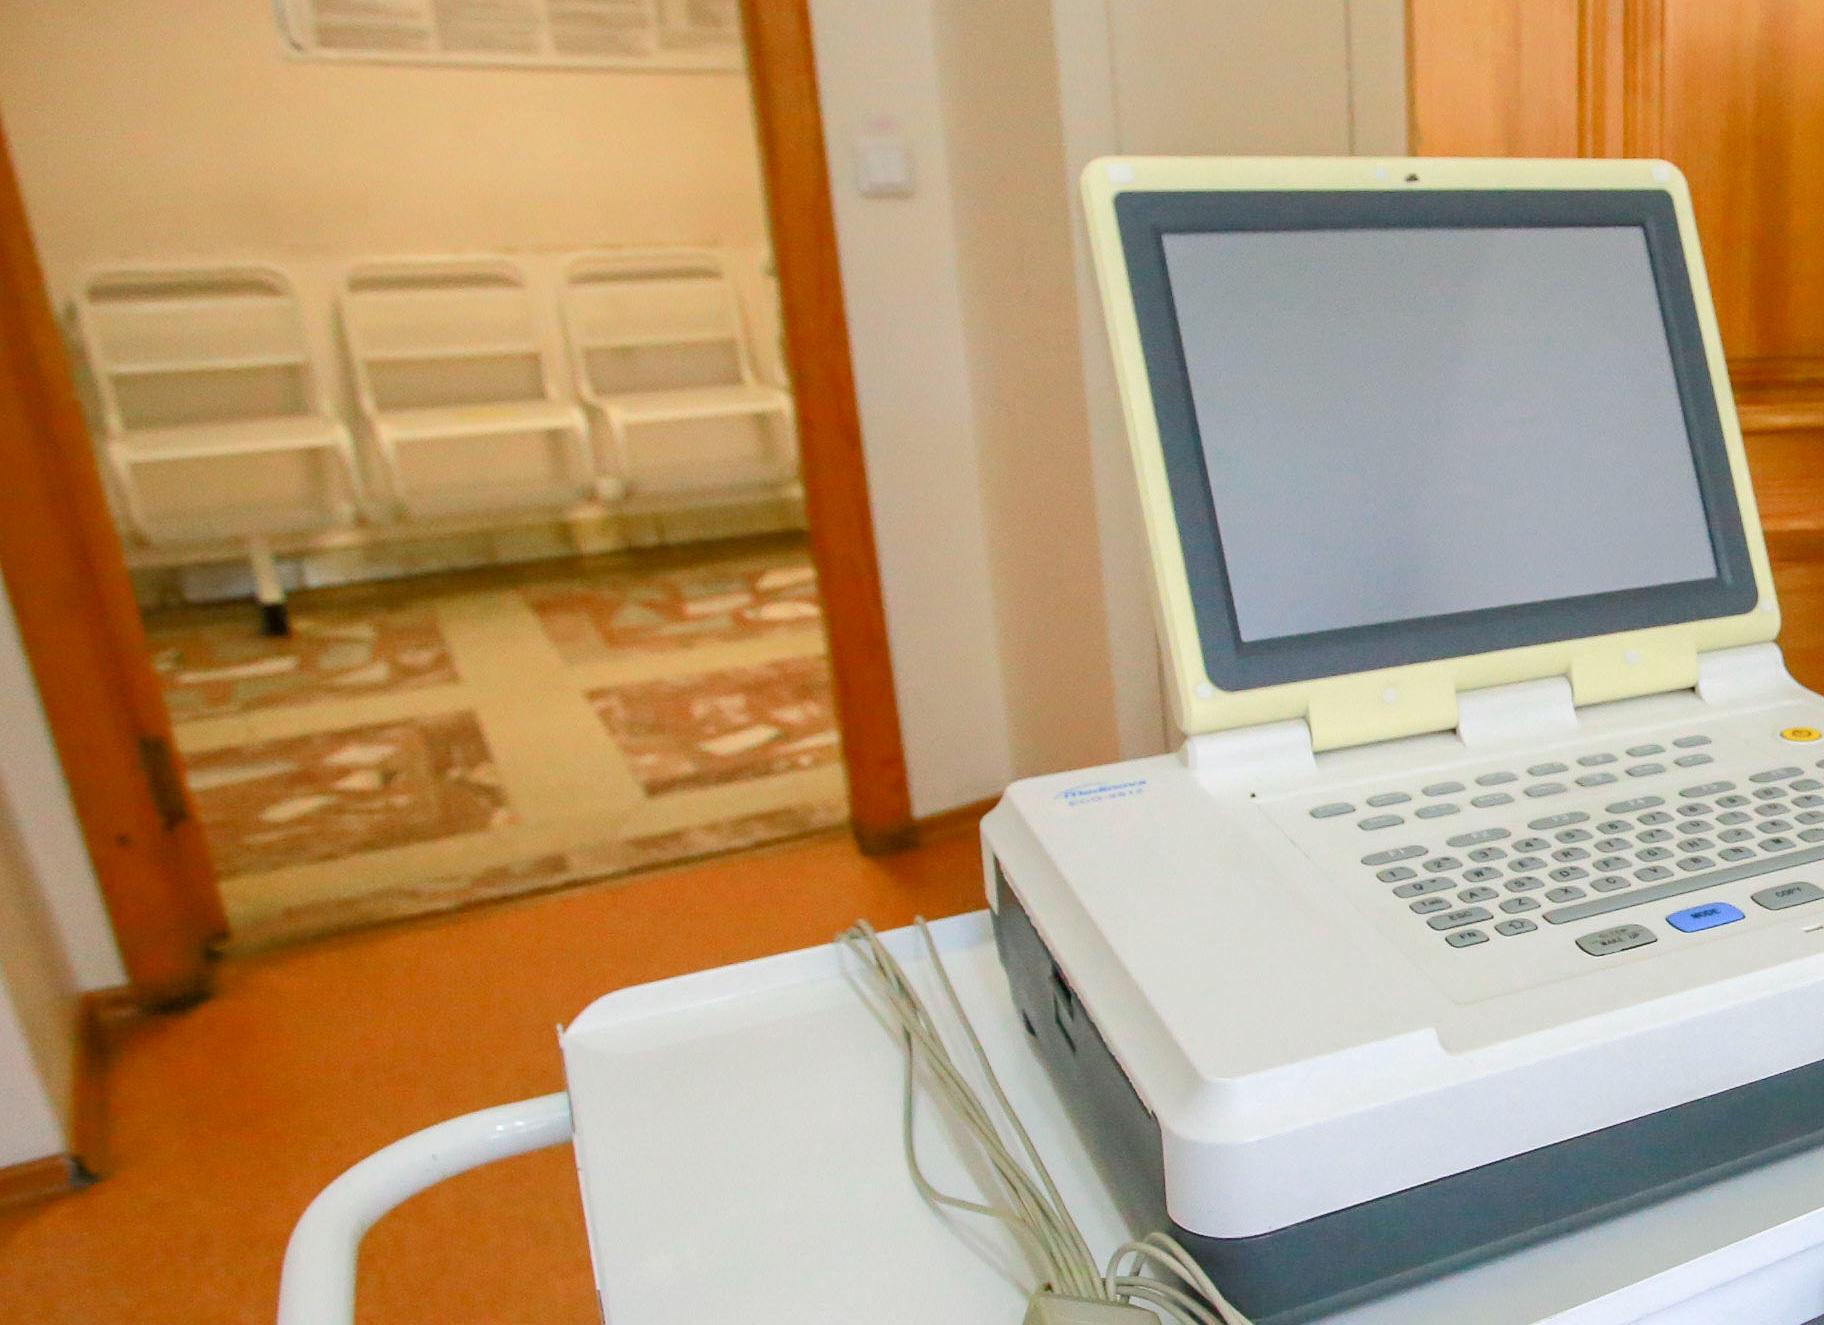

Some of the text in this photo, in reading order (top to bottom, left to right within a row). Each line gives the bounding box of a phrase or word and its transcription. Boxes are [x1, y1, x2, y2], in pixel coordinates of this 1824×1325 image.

[1412, 883, 1424, 892] Q
[1448, 910, 1473, 922] ESC
[1459, 930, 1477, 940] FN
